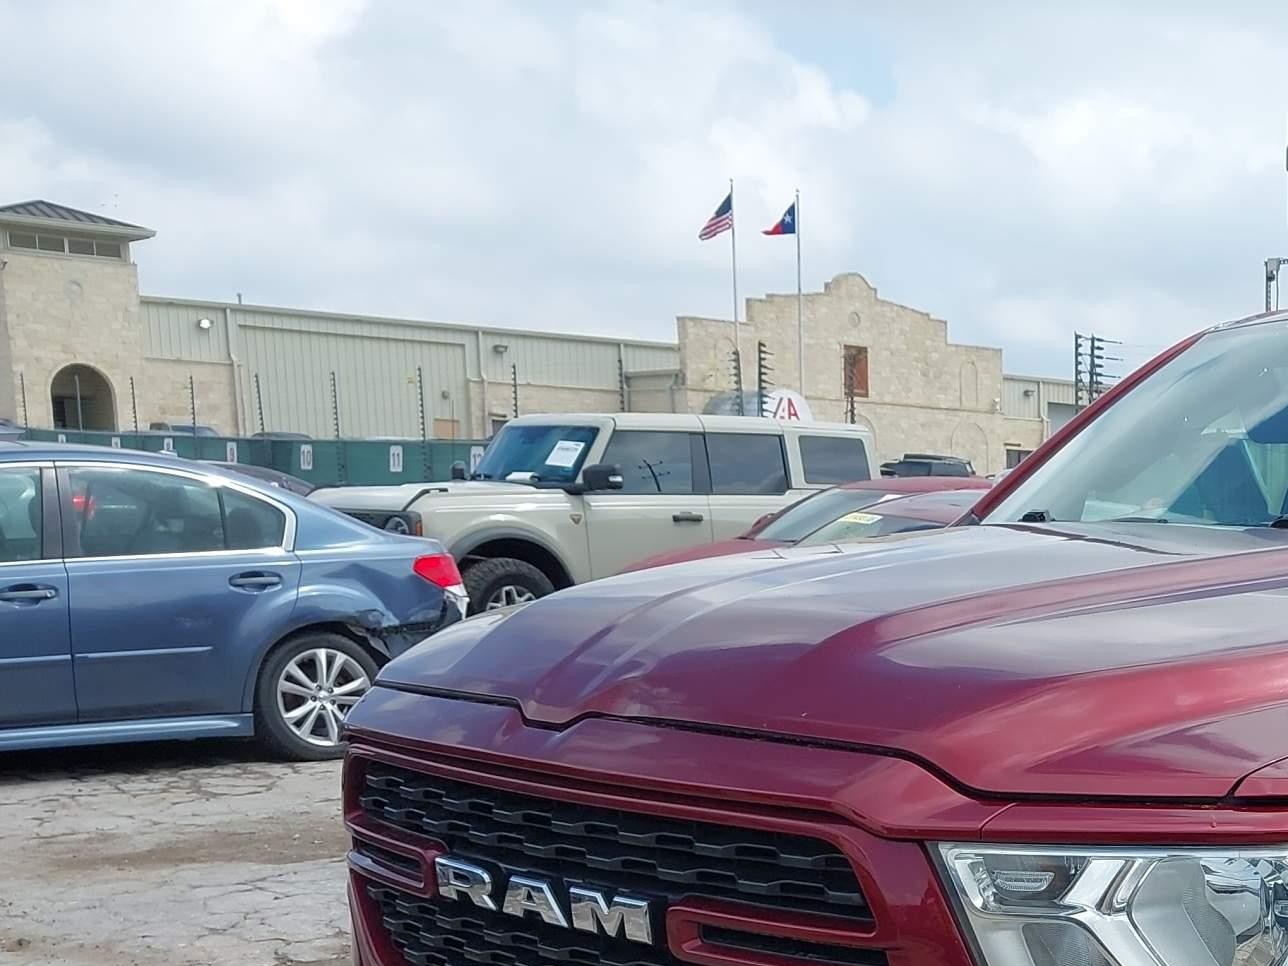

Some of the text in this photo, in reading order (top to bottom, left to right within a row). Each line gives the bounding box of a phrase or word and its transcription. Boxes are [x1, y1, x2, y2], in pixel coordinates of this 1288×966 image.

[301, 450, 312, 468] 10
[391, 452, 401, 468] 11
[435, 857, 653, 945] RAM
